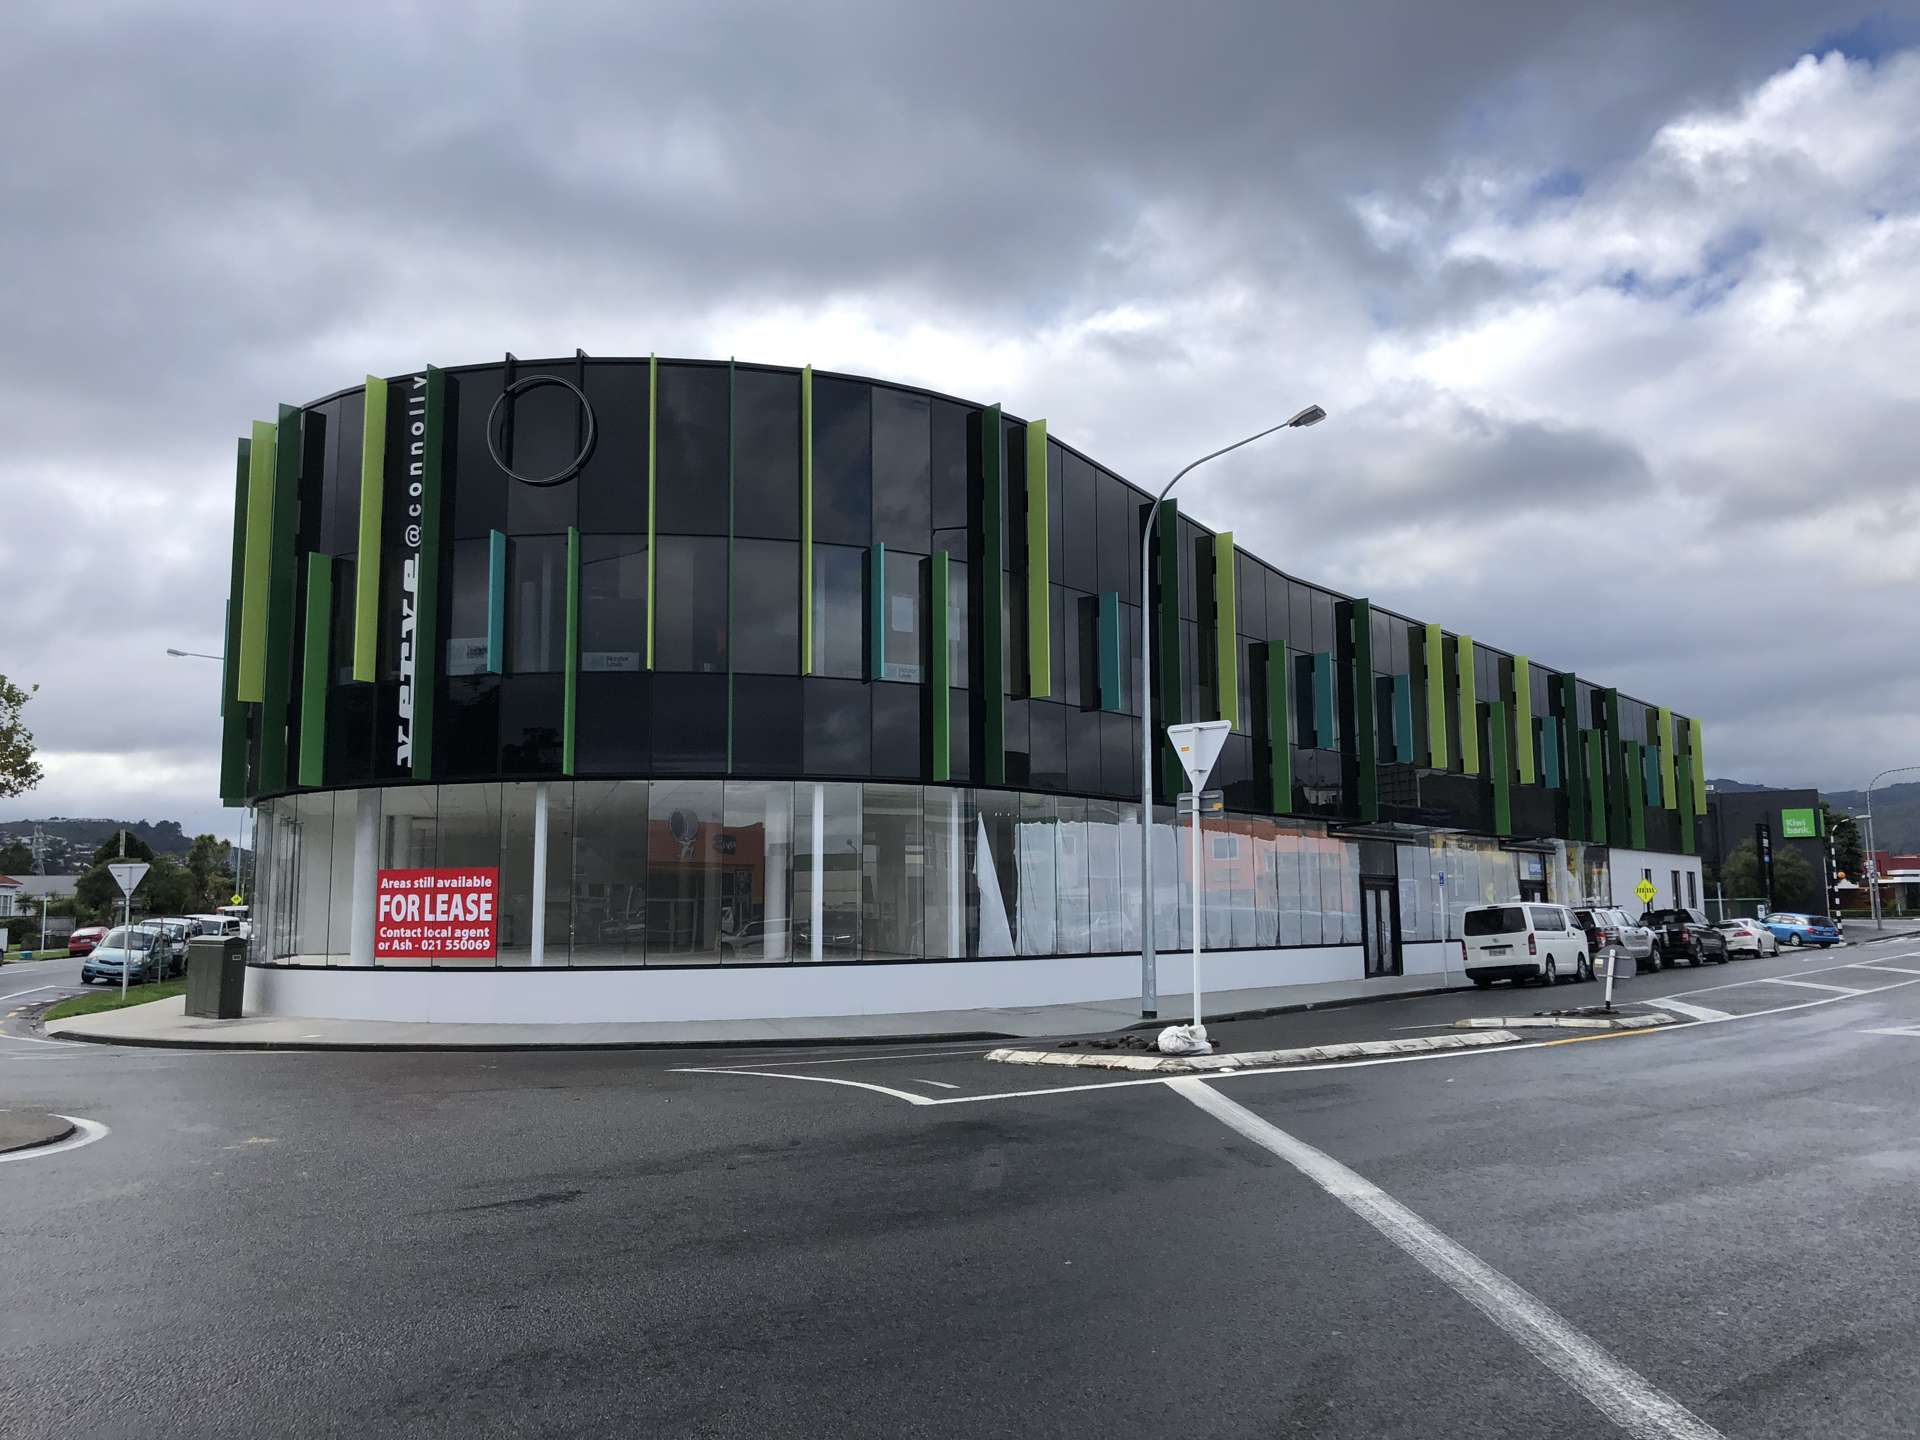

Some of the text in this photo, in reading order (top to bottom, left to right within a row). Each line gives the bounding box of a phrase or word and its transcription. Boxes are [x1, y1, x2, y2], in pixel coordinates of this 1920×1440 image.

[381, 875, 492, 889] Areas still available
[379, 893, 493, 922] FOR LEASE
[379, 926, 490, 940] Contact local agent
[378, 941, 390, 950] or
[392, 939, 412, 950] Ash
[421, 940, 441, 950] 021
[445, 940, 490, 950] 550069
